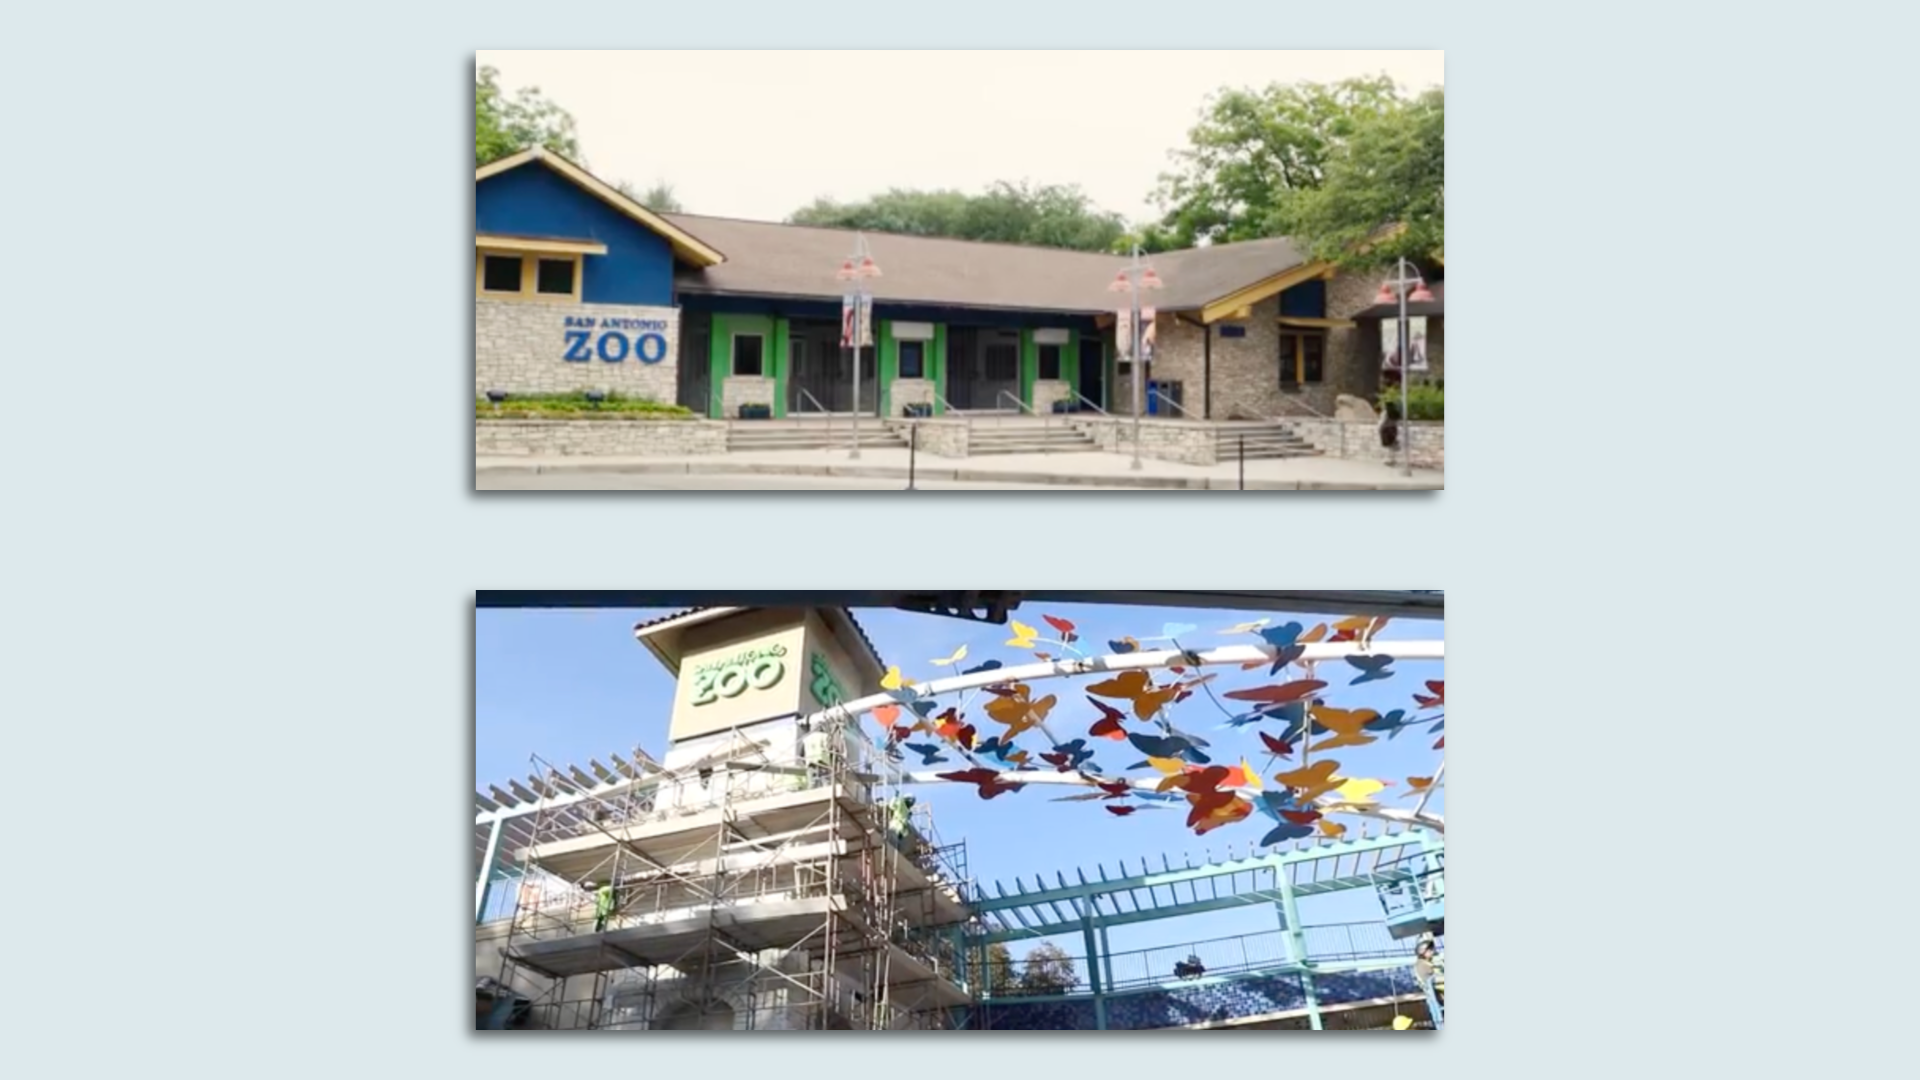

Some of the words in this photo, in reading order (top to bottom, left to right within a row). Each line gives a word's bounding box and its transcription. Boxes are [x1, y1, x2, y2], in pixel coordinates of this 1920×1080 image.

[564, 316, 596, 328] SAN
[601, 318, 668, 330] ANTONIO
[563, 330, 667, 365] ZOO
[690, 656, 785, 706] ZOO
